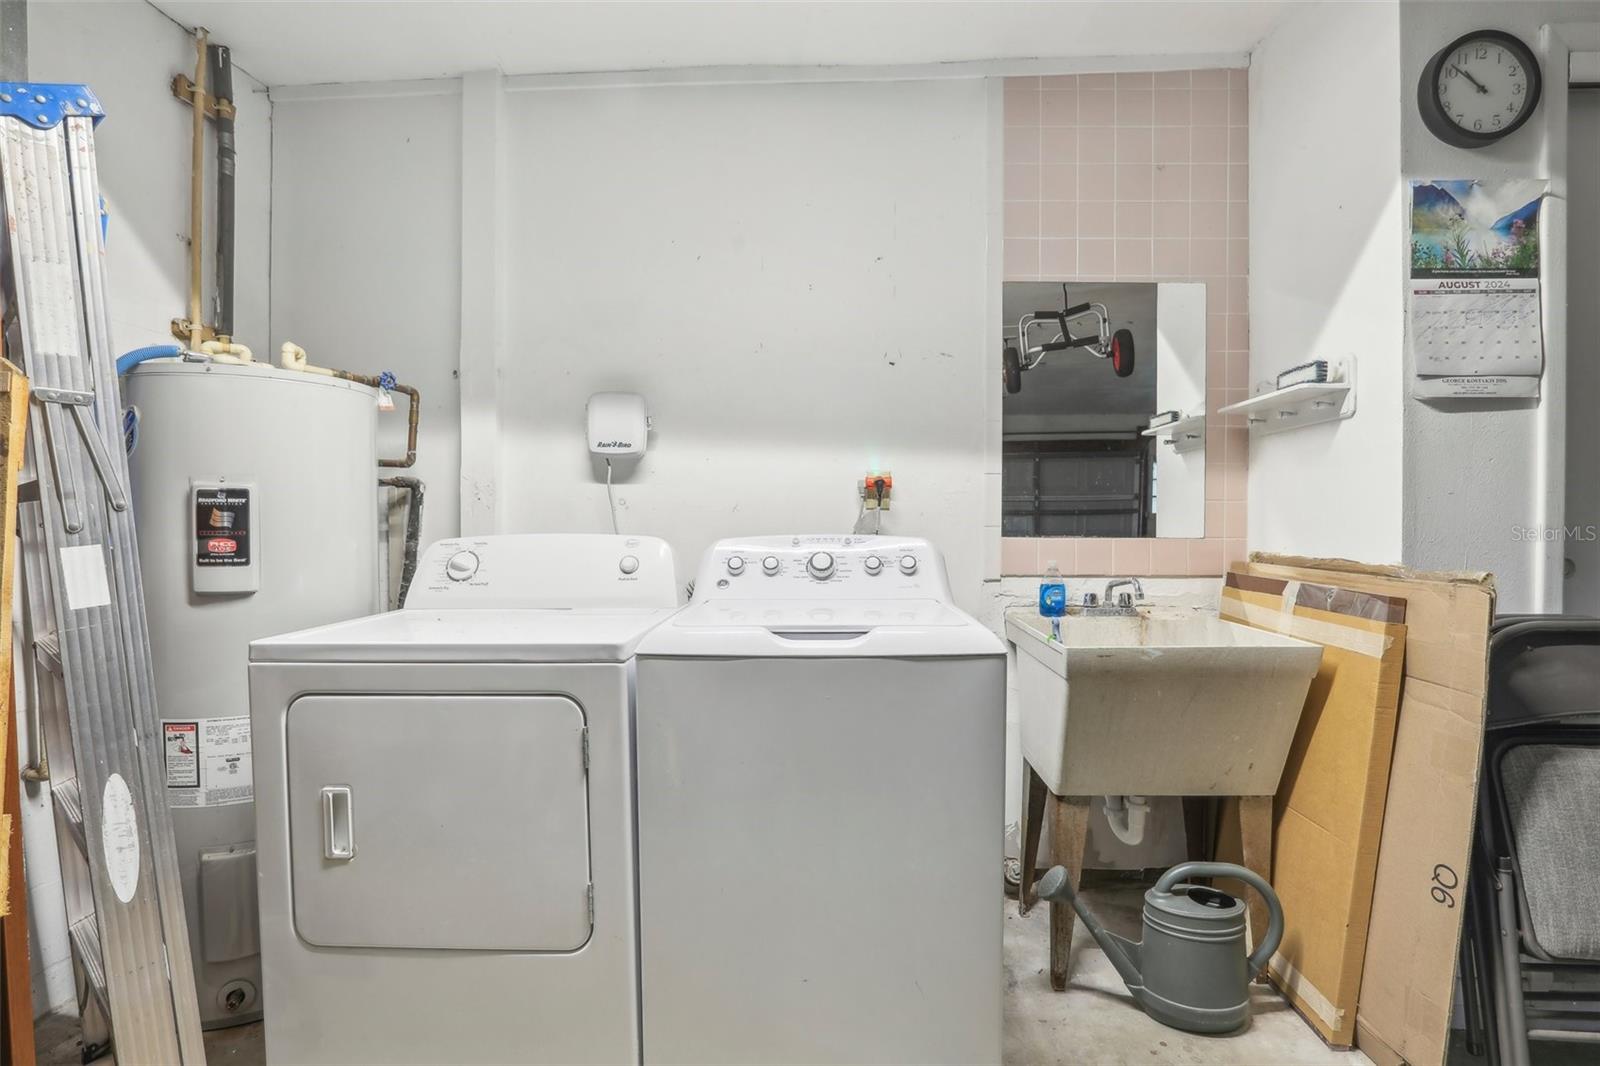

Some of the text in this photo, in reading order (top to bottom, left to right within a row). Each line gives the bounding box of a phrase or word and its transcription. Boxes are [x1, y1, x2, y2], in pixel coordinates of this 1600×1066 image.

[1458, 52, 1469, 65] 11
[1475, 48, 1488, 60] 12
[1497, 53, 1502, 65] 1
[1445, 67, 1459, 79] 10
[1509, 66, 1517, 77] 2
[1439, 84, 1448, 96] 9
[1512, 84, 1521, 96] 3
[1443, 101, 1452, 113] 8
[1507, 103, 1515, 114] 4
[1456, 115, 1465, 127] 7
[1474, 120, 1483, 131] 6
[1493, 115, 1502, 127] 5
[1438, 280, 1511, 289] AUGUST 2024
[1431, 863, 1458, 909] 90
